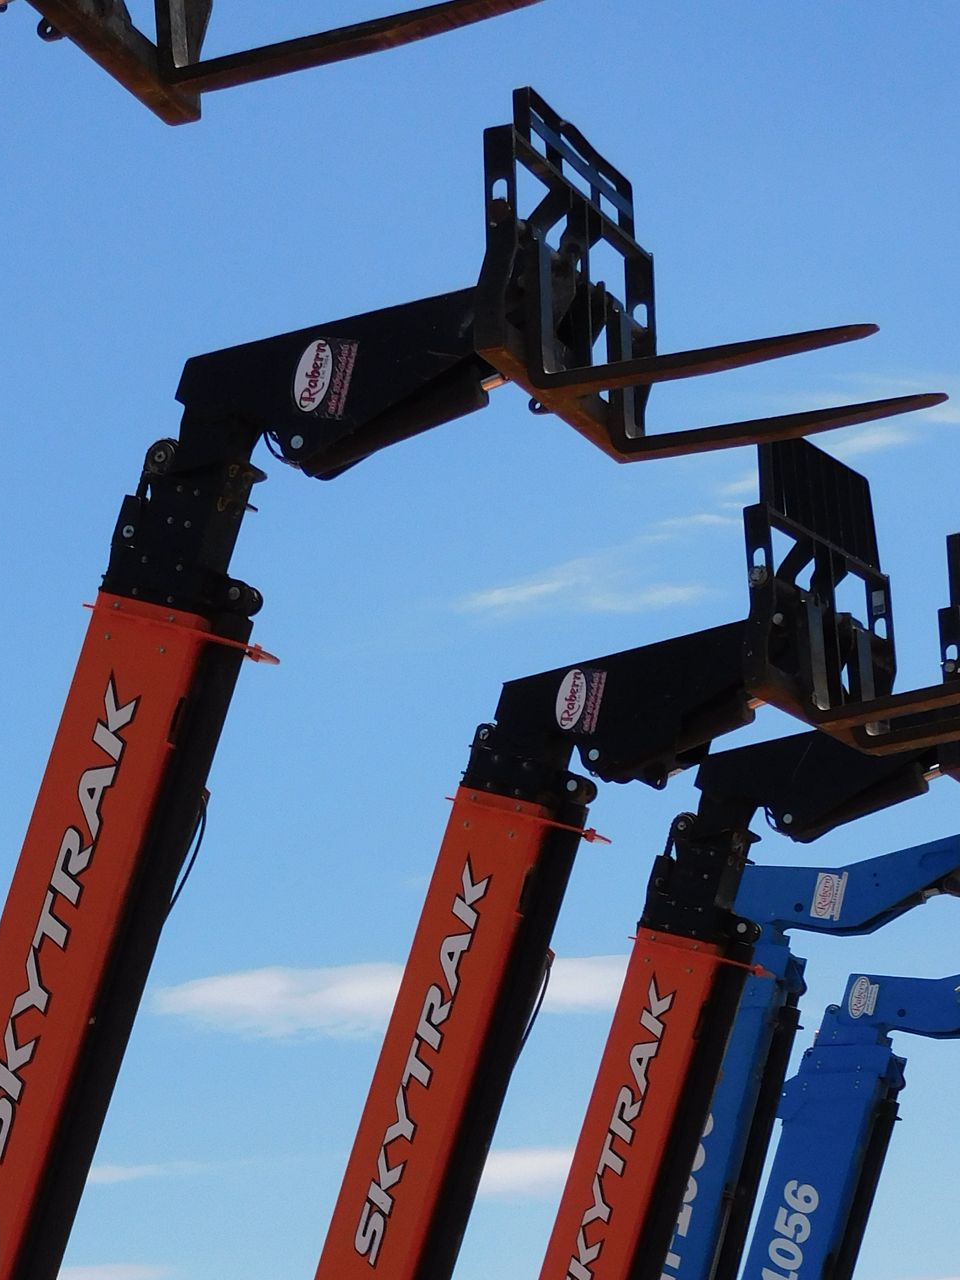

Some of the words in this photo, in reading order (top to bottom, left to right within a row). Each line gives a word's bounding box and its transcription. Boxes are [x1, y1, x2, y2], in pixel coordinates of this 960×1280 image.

[300, 341, 328, 409] Rabern
[560, 671, 583, 727] Rabern
[354, 853, 493, 1269] SKYTRAK
